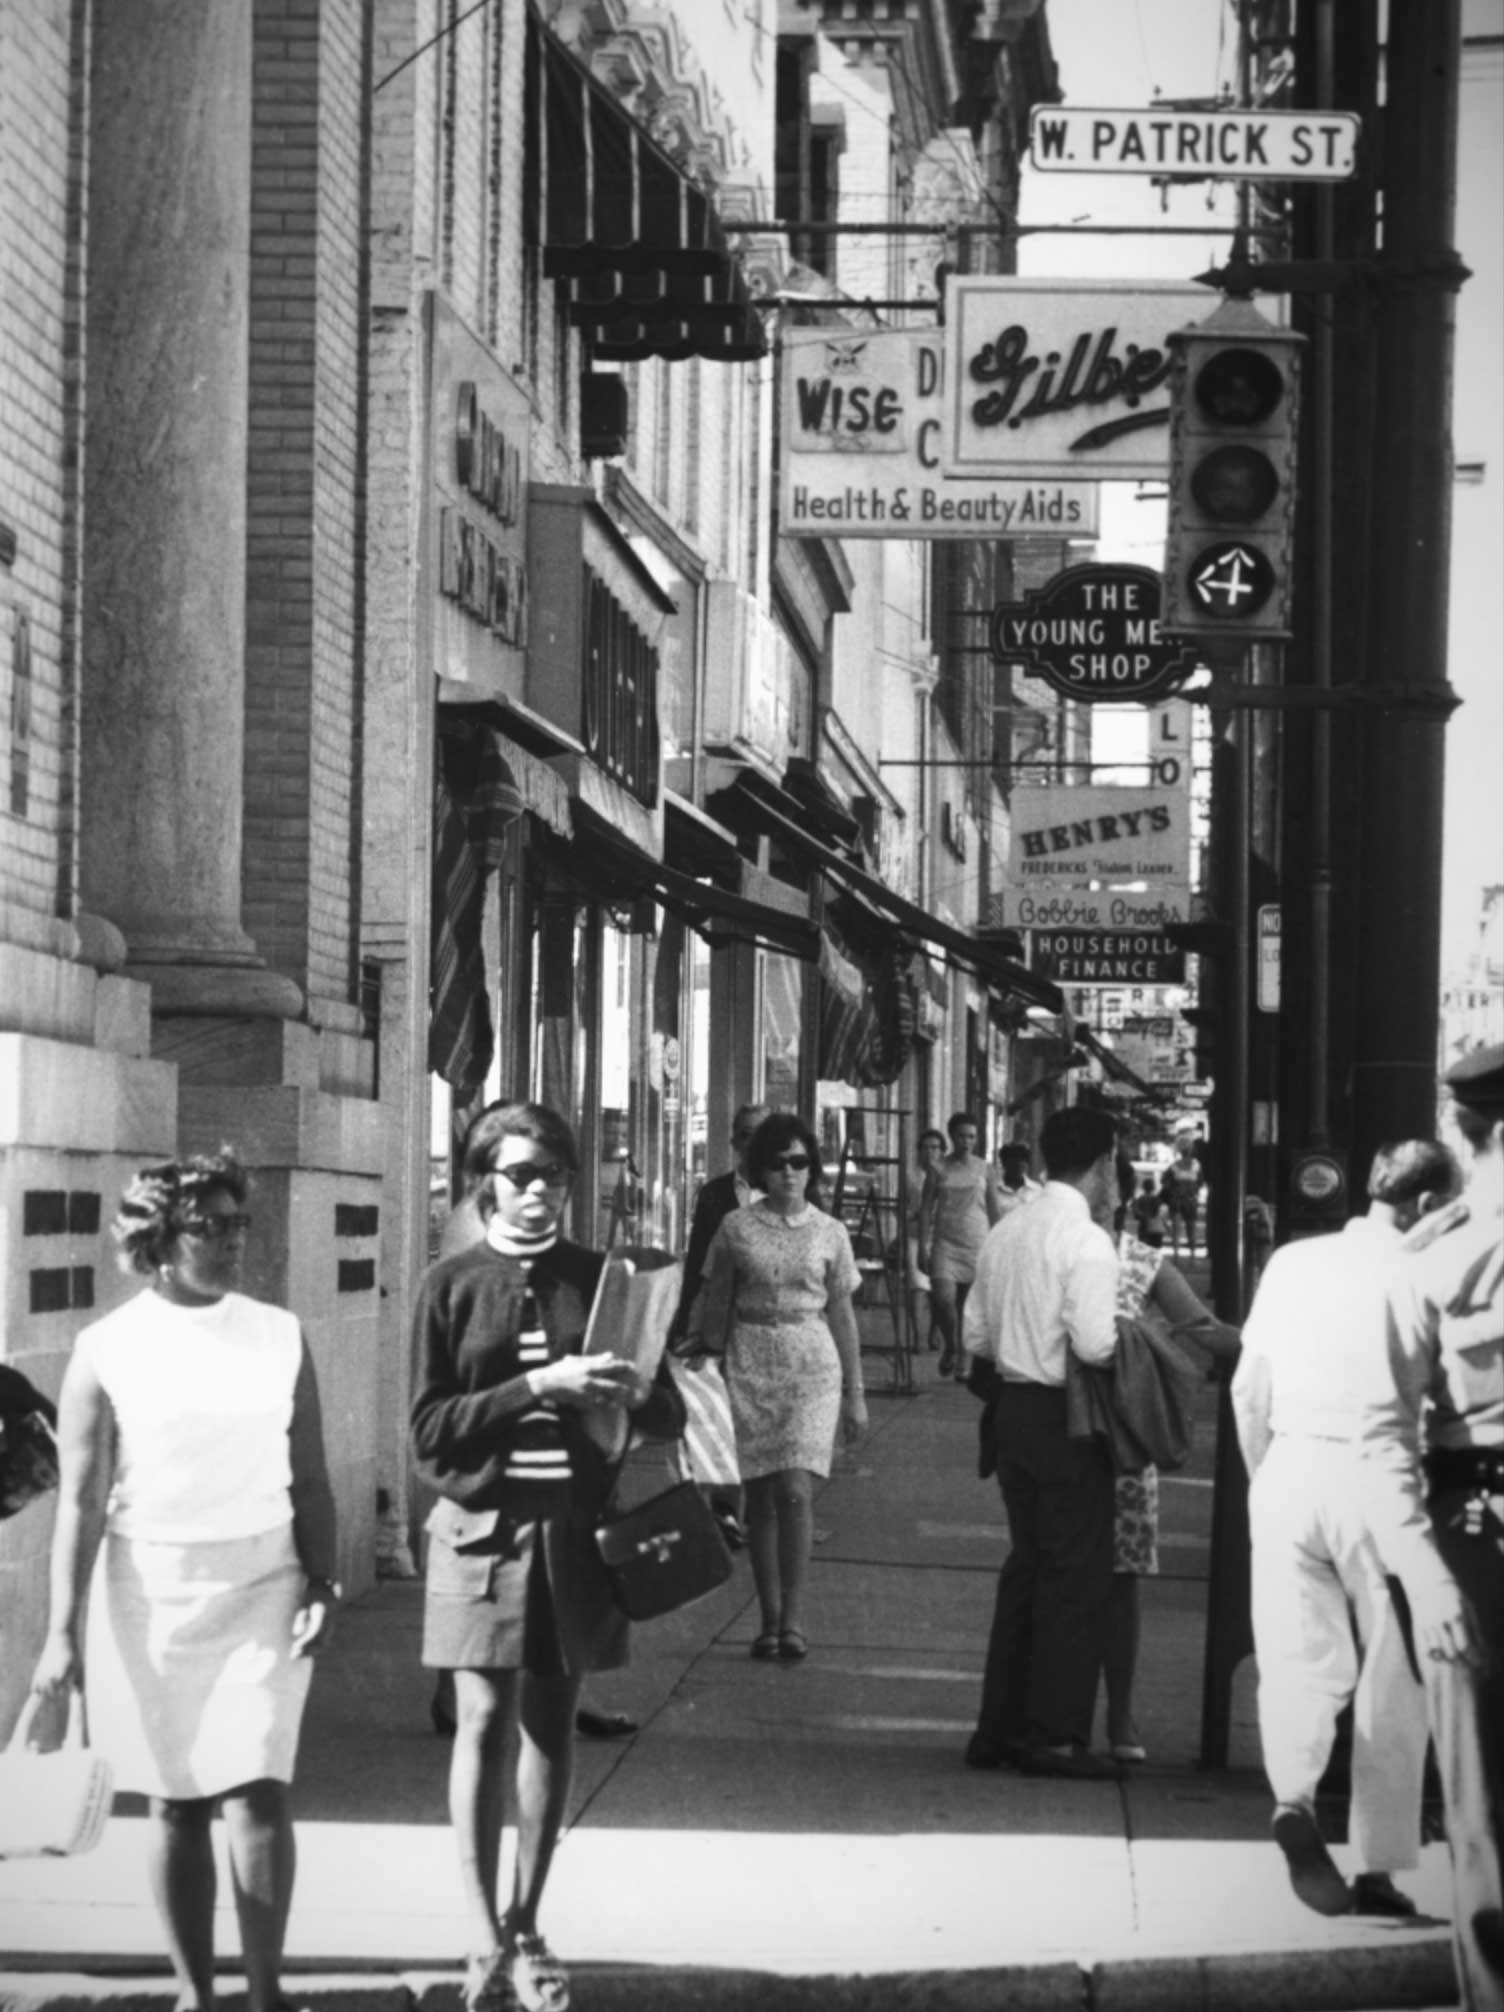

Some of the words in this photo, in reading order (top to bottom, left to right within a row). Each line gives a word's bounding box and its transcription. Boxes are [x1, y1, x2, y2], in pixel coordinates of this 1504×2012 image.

[1040, 120, 1075, 160] W.
[1093, 121, 1268, 165] PATRICK
[1291, 125, 1351, 167] ST.
[797, 377, 904, 433] WISE
[794, 486, 885, 522] Health
[890, 487, 911, 521] &
[921, 489, 1017, 531] Beauty
[1019, 488, 1081, 523] Aids
[1082, 584, 1139, 611] THE
[1012, 619, 1104, 646] YOUNG
[1069, 654, 1151, 680] SHOP
[1021, 805, 1170, 858] HENRY'S
[1058, 959, 1157, 979] FINANCE
